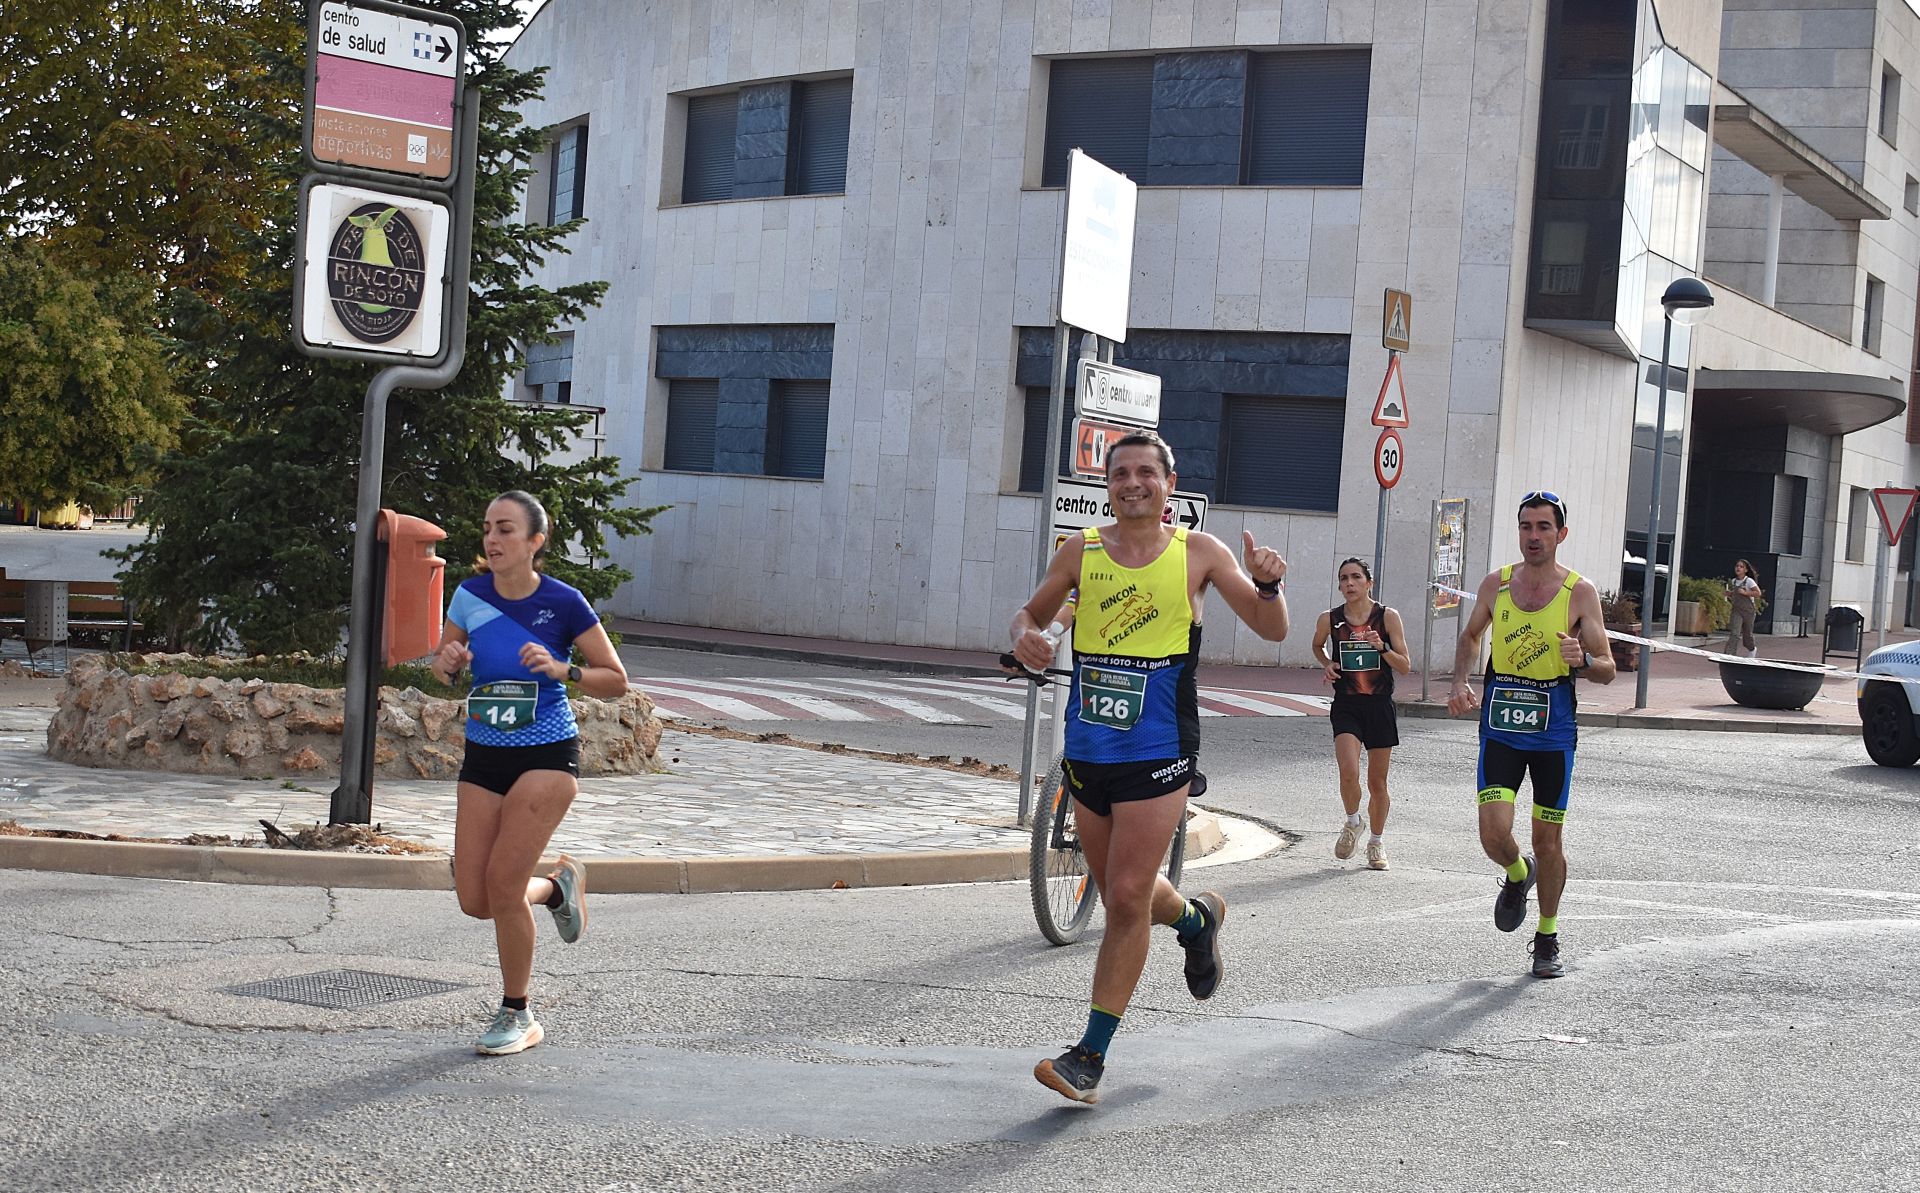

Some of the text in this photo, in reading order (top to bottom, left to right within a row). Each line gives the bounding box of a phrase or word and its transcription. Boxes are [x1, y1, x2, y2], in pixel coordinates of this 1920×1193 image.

[324, 10, 359, 27] centro
[323, 26, 386, 55] de salud
[334, 261, 419, 293] RINCÓN
[344, 284, 406, 304] DE SOTO
[1110, 384, 1132, 404] centro
[1382, 449, 1397, 468] 30
[1056, 494, 1097, 515] centro
[1100, 584, 1137, 612] RINCON
[1108, 608, 1159, 648] ATLETISMO
[1504, 622, 1532, 645] RINCON
[1109, 657, 1131, 667] SOTO
[1136, 660, 1147, 669] LA
[1355, 655, 1363, 666] 1
[1516, 644, 1550, 671] ATLETISMO
[486, 706, 517, 725] 14
[1090, 694, 1129, 720] 126
[1500, 708, 1538, 725] 194
